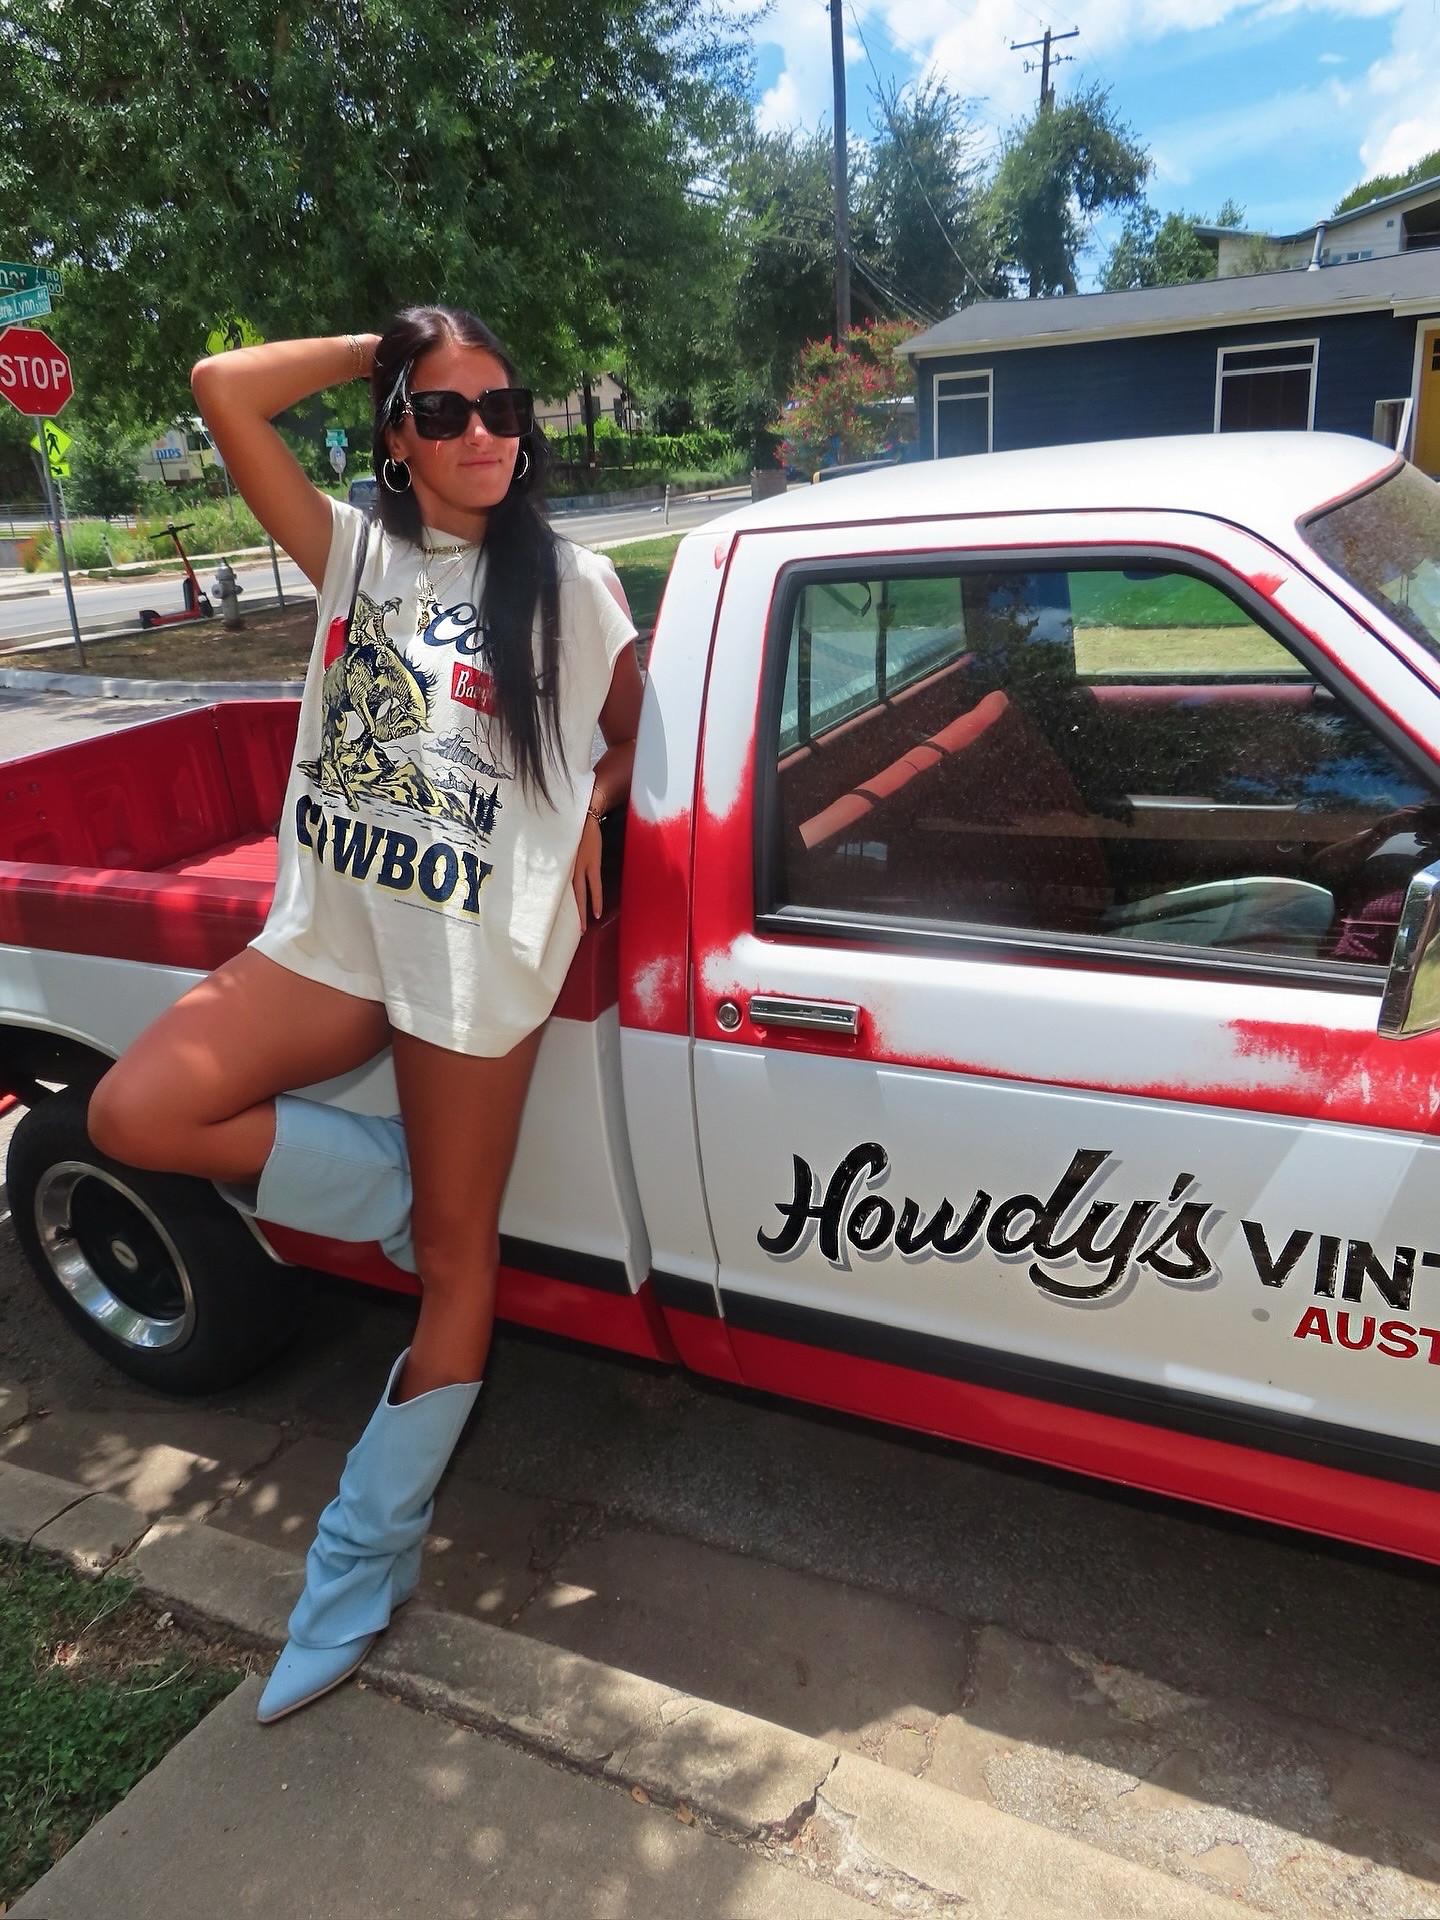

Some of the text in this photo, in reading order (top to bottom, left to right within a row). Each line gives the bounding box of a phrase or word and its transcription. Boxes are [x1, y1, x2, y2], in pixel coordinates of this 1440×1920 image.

[45, 269, 60, 281] RD
[13, 298, 36, 317] Lynn
[37, 287, 48, 300] AVE
[0, 354, 67, 391] STOP
[155, 447, 182, 460] DIPS
[757, 1141, 1216, 1301] Howdy's
